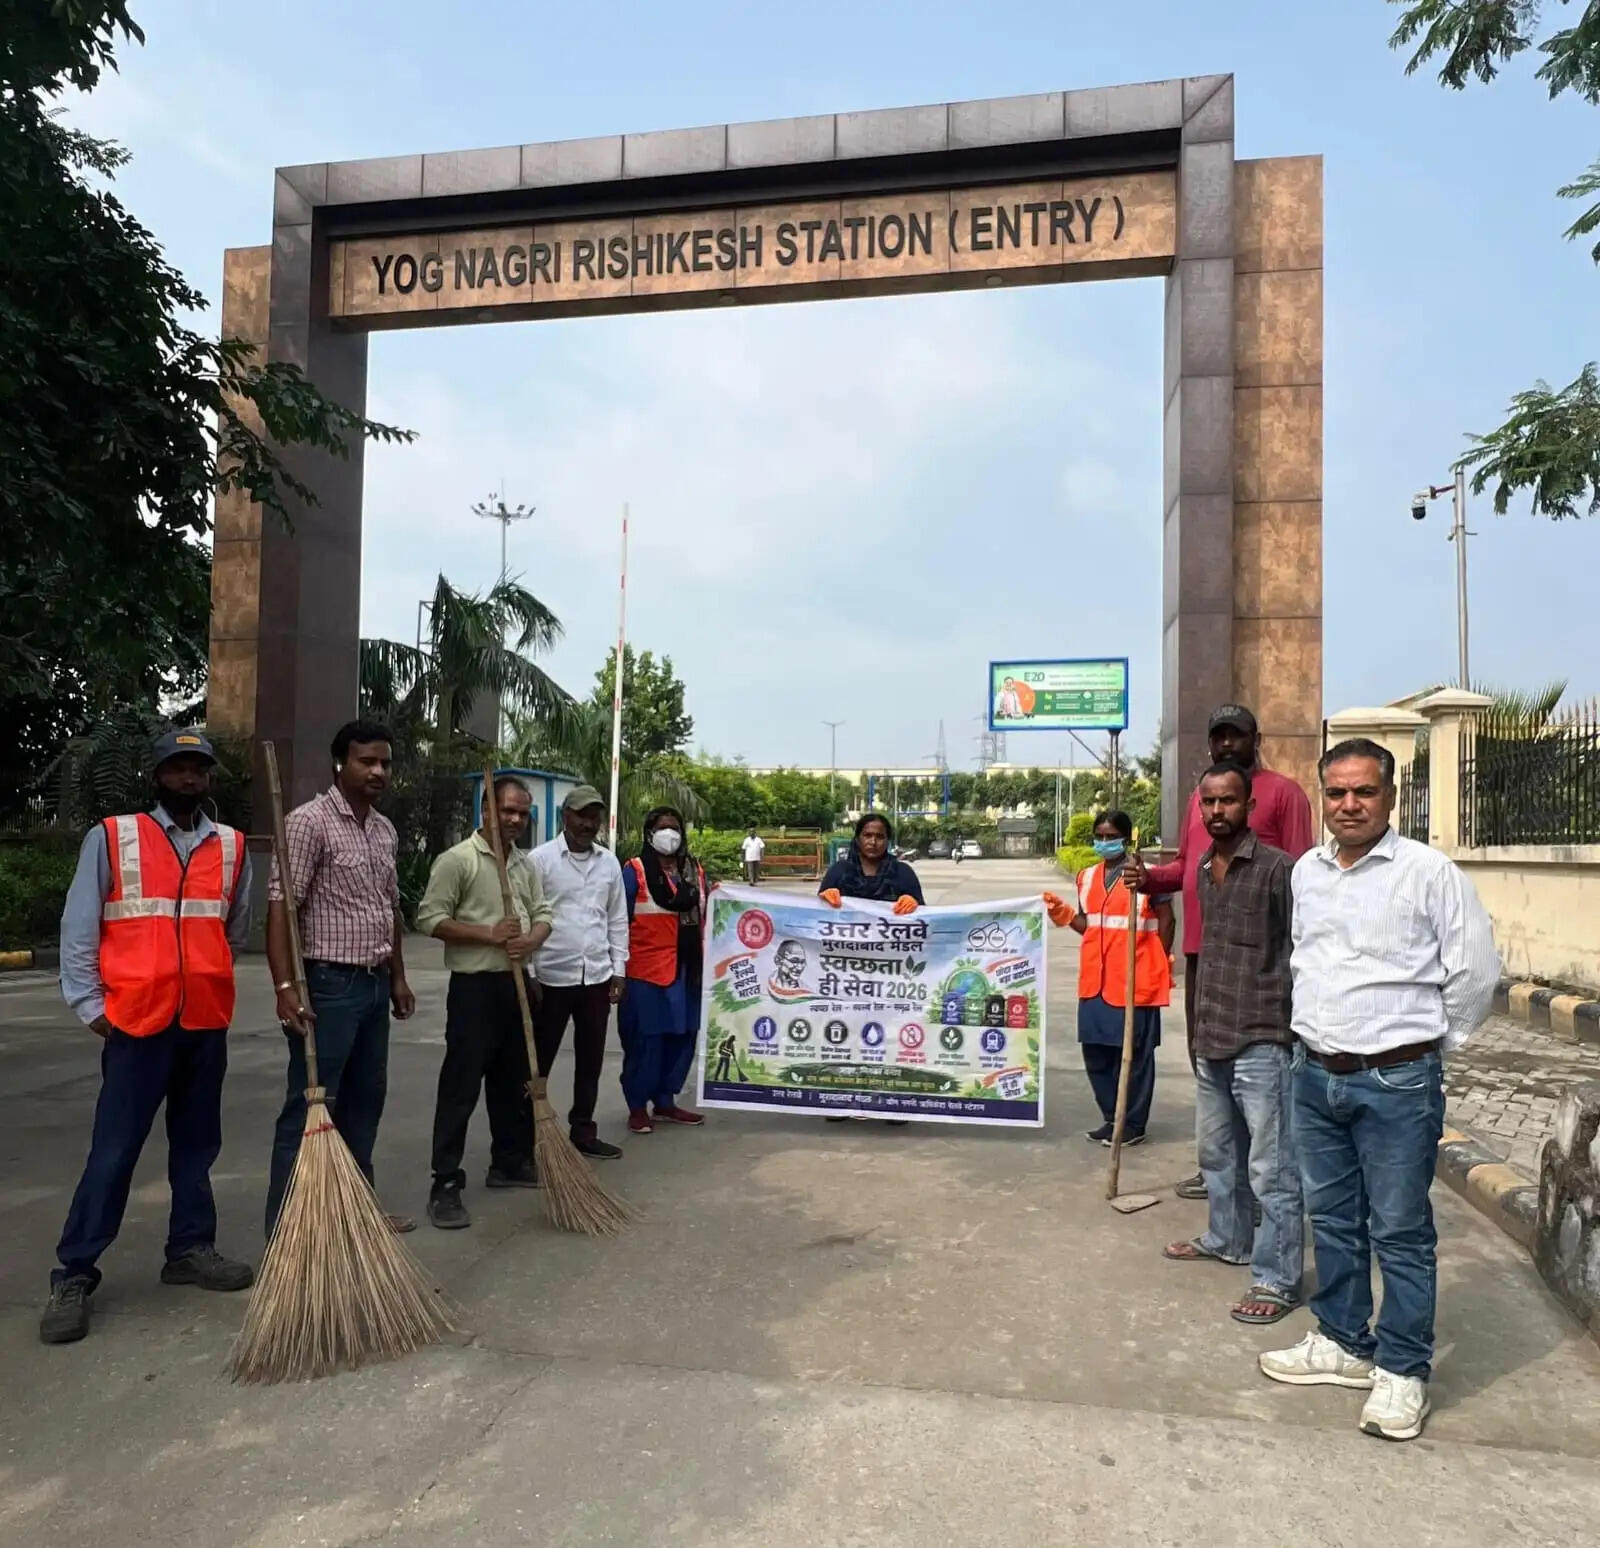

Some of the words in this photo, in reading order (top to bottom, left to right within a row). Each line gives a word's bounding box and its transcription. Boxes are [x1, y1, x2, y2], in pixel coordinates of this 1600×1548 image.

[372, 251, 444, 295] YOG
[454, 242, 563, 290] NAGRI
[572, 224, 763, 283] RISHIKESH
[774, 210, 932, 266] STATION
[1023, 671, 1046, 682] E20
[818, 920, 871, 938] उत्तर
[876, 917, 929, 940] रेलवे
[822, 940, 885, 952] मुरादाबाद
[819, 955, 903, 975] स्वच्छता
[818, 972, 841, 996] ही
[843, 973, 884, 998] सेवा
[885, 981, 927, 1001] 2026
